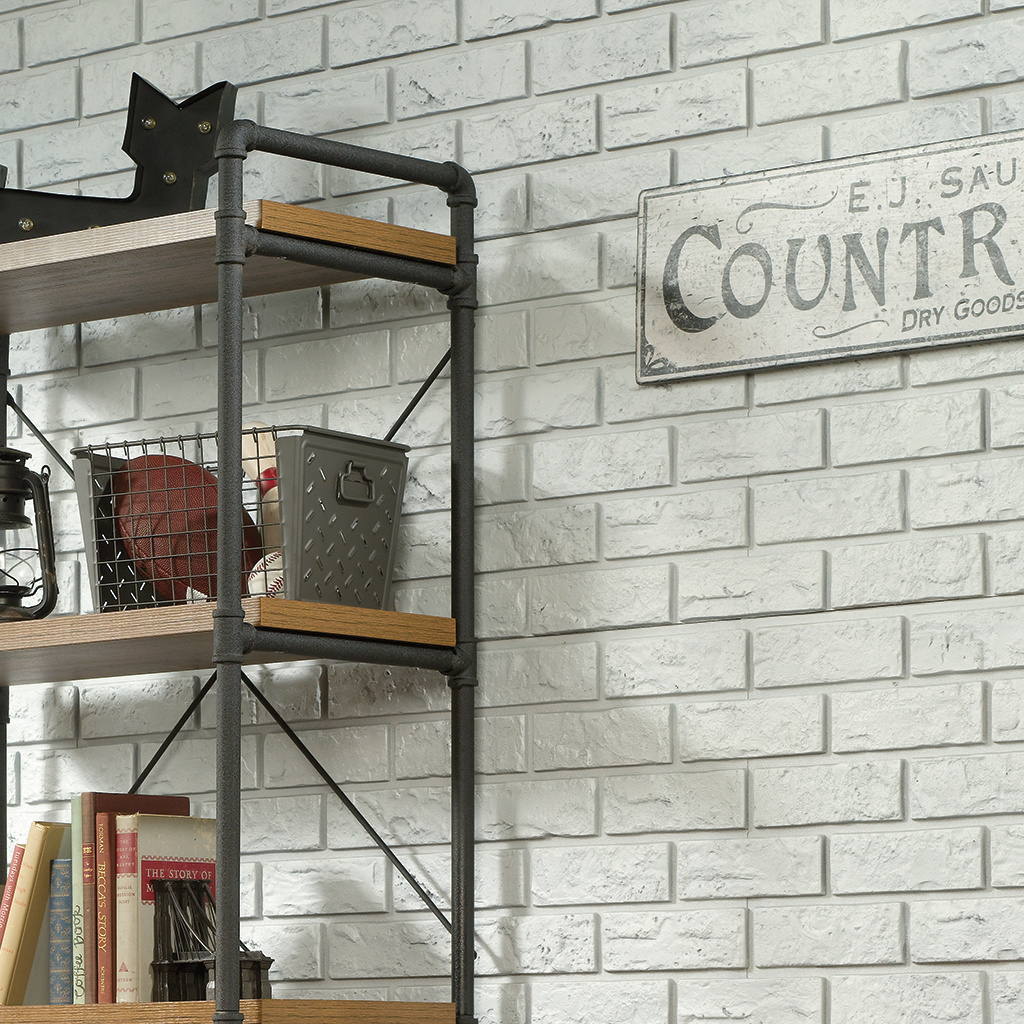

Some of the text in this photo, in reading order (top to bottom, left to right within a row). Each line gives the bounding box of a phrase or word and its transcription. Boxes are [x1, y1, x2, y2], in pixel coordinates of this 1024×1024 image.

[901, 305, 945, 333] DRY
[145, 868, 213, 880] THE STORY OF
[4, 885, 14, 902] with
[97, 861, 108, 953] BECCA'S STORY
